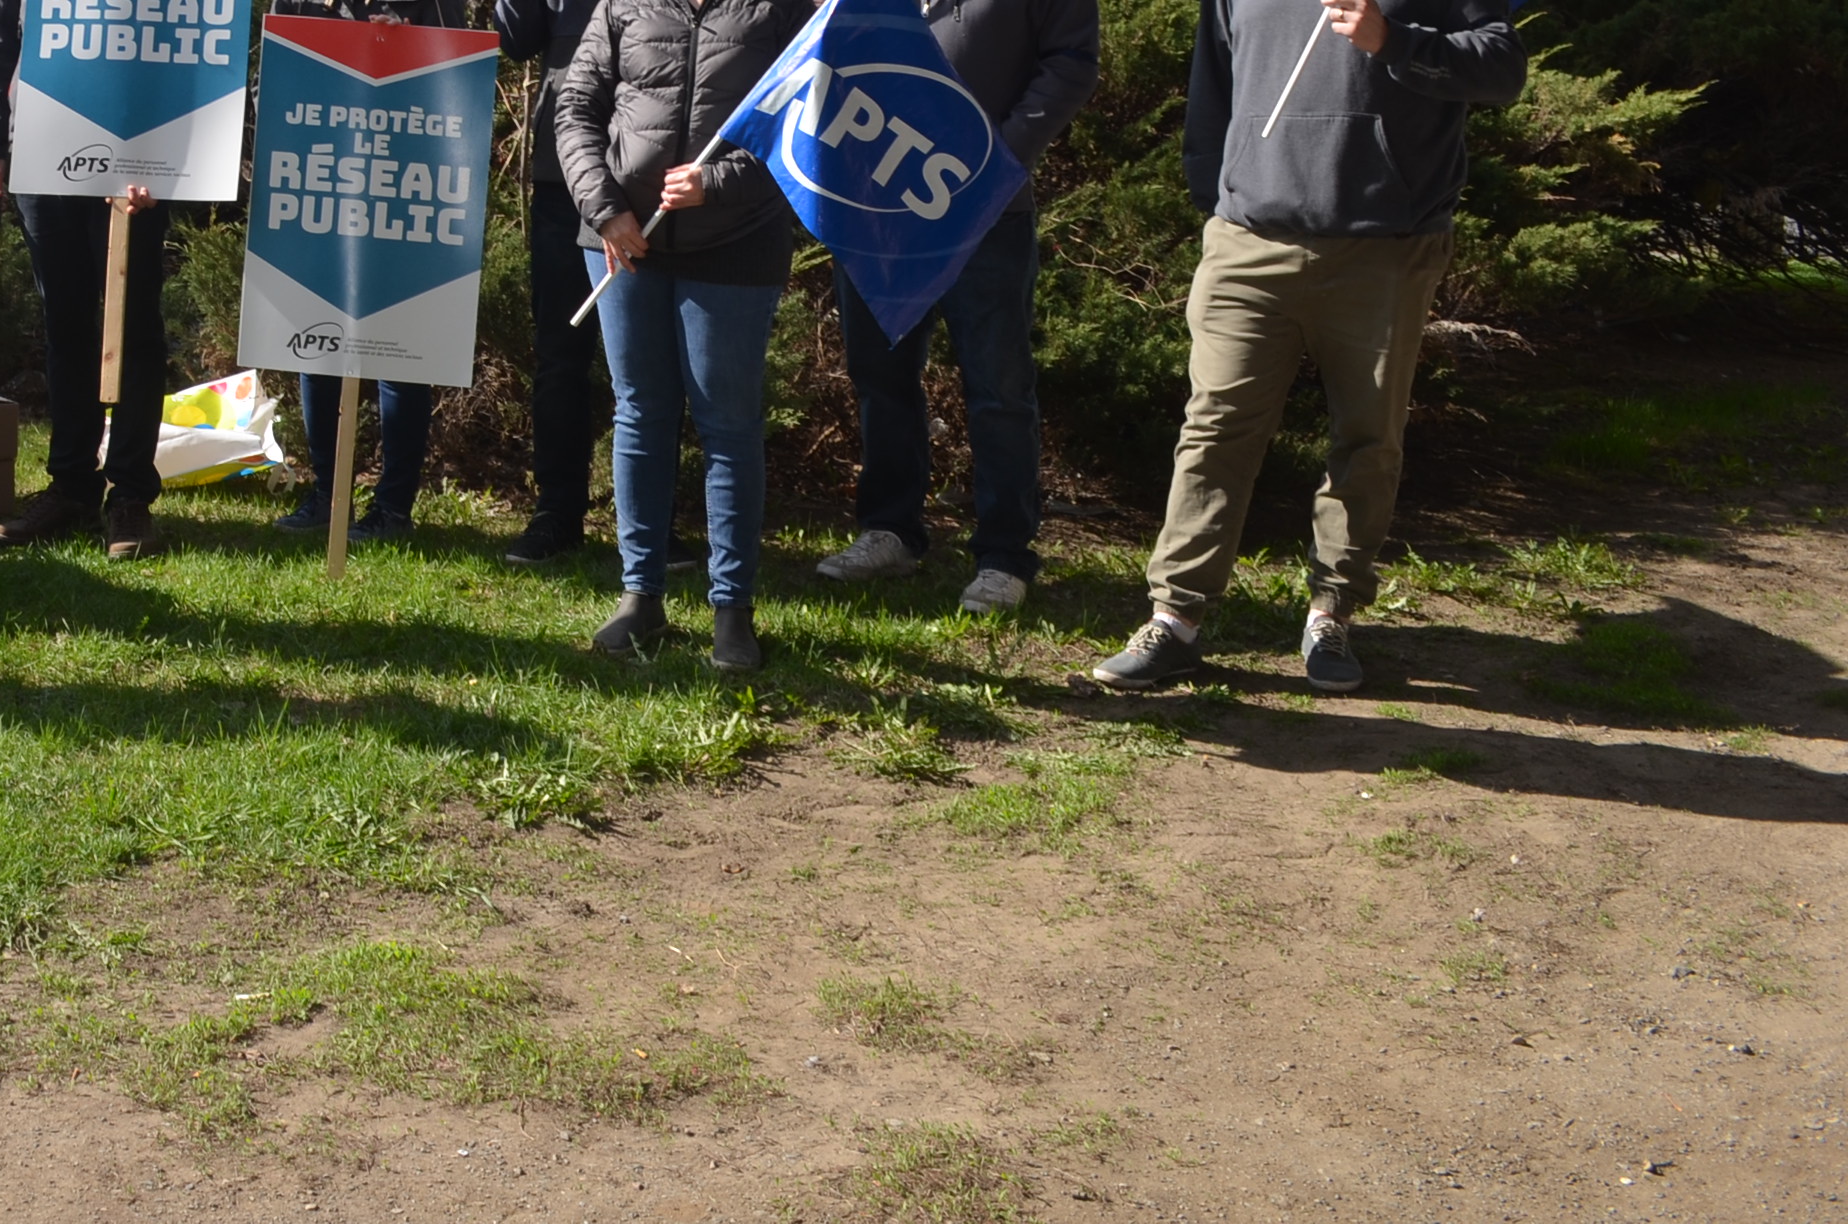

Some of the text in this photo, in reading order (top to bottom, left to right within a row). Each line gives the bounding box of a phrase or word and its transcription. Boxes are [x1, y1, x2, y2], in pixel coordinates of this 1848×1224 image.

[39, 23, 231, 66] PUBLIC
[285, 103, 463, 138] JE PROTÈGE
[754, 58, 971, 220] APTS
[353, 132, 391, 156] LE
[56, 156, 110, 174] APTS
[269, 143, 471, 204] RÉSEAU
[268, 192, 466, 246] PUBLIC
[286, 333, 341, 353] APTS
